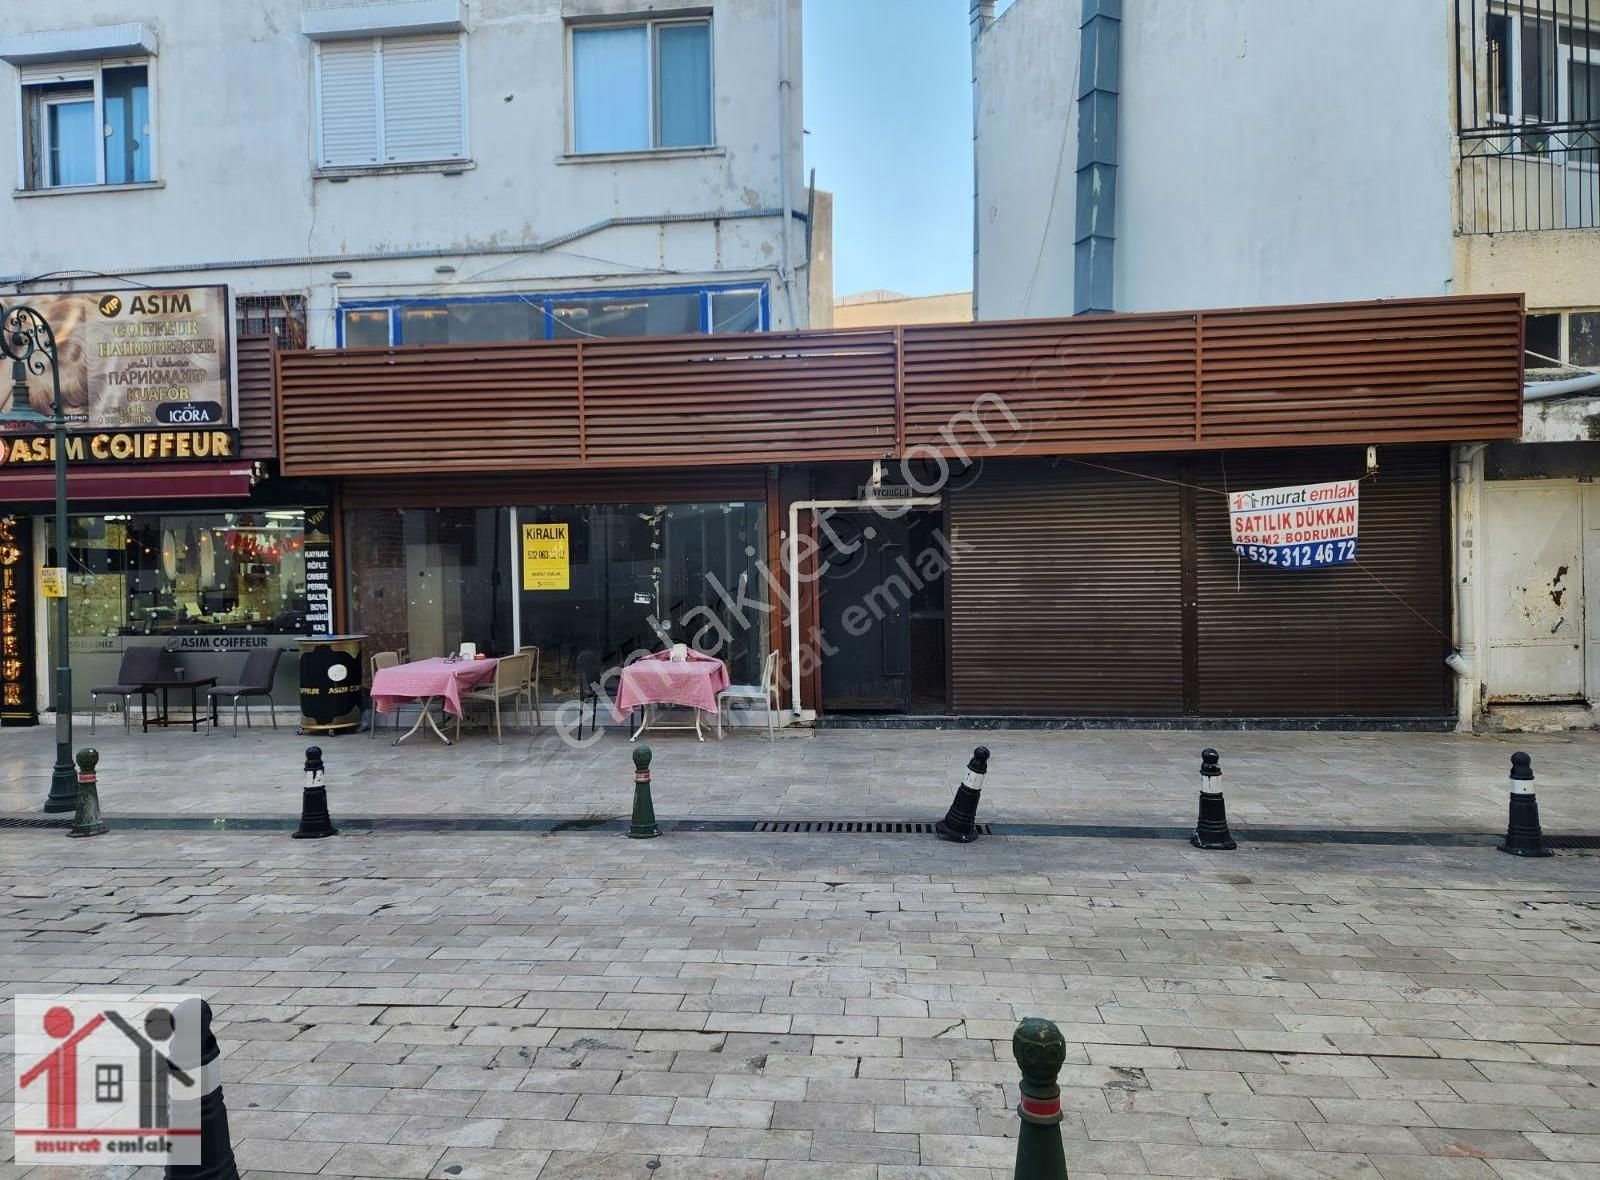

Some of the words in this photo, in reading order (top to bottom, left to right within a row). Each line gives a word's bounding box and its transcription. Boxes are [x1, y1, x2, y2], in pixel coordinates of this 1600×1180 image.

[101, 298, 119, 315] VIP
[129, 294, 192, 315] ASIM
[113, 320, 199, 338] COIFFEUR
[97, 339, 217, 358] HAIRDRESSER
[108, 368, 208, 386] ПАРИКМАХЕР
[126, 383, 190, 401] KUAFÖR
[169, 409, 210, 423] IGORA
[9, 437, 84, 462] ASIM
[91, 432, 232, 460] COIFFEUR
[1261, 488, 1307, 507] murat
[1309, 482, 1356, 502] emlak
[1235, 511, 1292, 533] SATILIK
[1296, 504, 1355, 528] DÜKKAN
[1262, 534, 1280, 545] M2
[1285, 525, 1355, 544] BODRUMLU
[1249, 545, 1278, 566] 532
[1281, 545, 1312, 567] 312
[1315, 543, 1334, 564] 46
[1338, 540, 1356, 561] 72
[181, 637, 210, 648] ASIM
[212, 637, 269, 648] COIFFEUR
